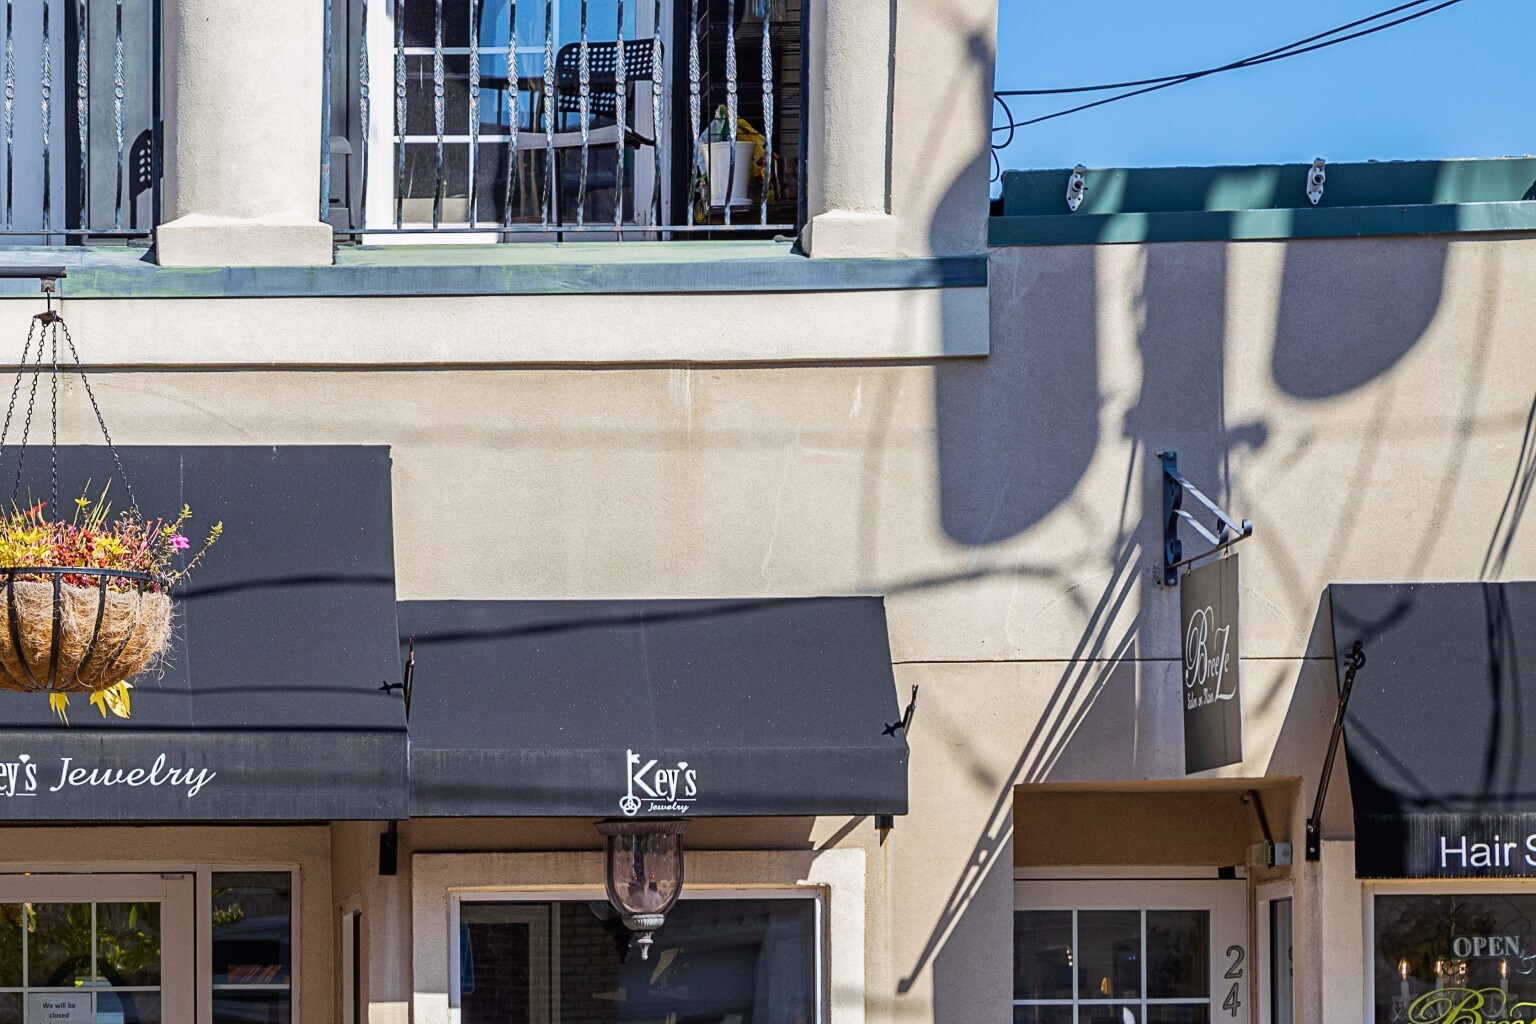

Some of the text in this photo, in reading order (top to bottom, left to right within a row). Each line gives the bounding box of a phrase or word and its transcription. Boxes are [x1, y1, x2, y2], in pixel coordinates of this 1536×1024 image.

[49, 752, 216, 798] Jewelry
[619, 749, 697, 816] Key's
[647, 801, 690, 813] Jewelry
[1440, 834, 1518, 868] Hair
[1452, 935, 1521, 957] OPEN
